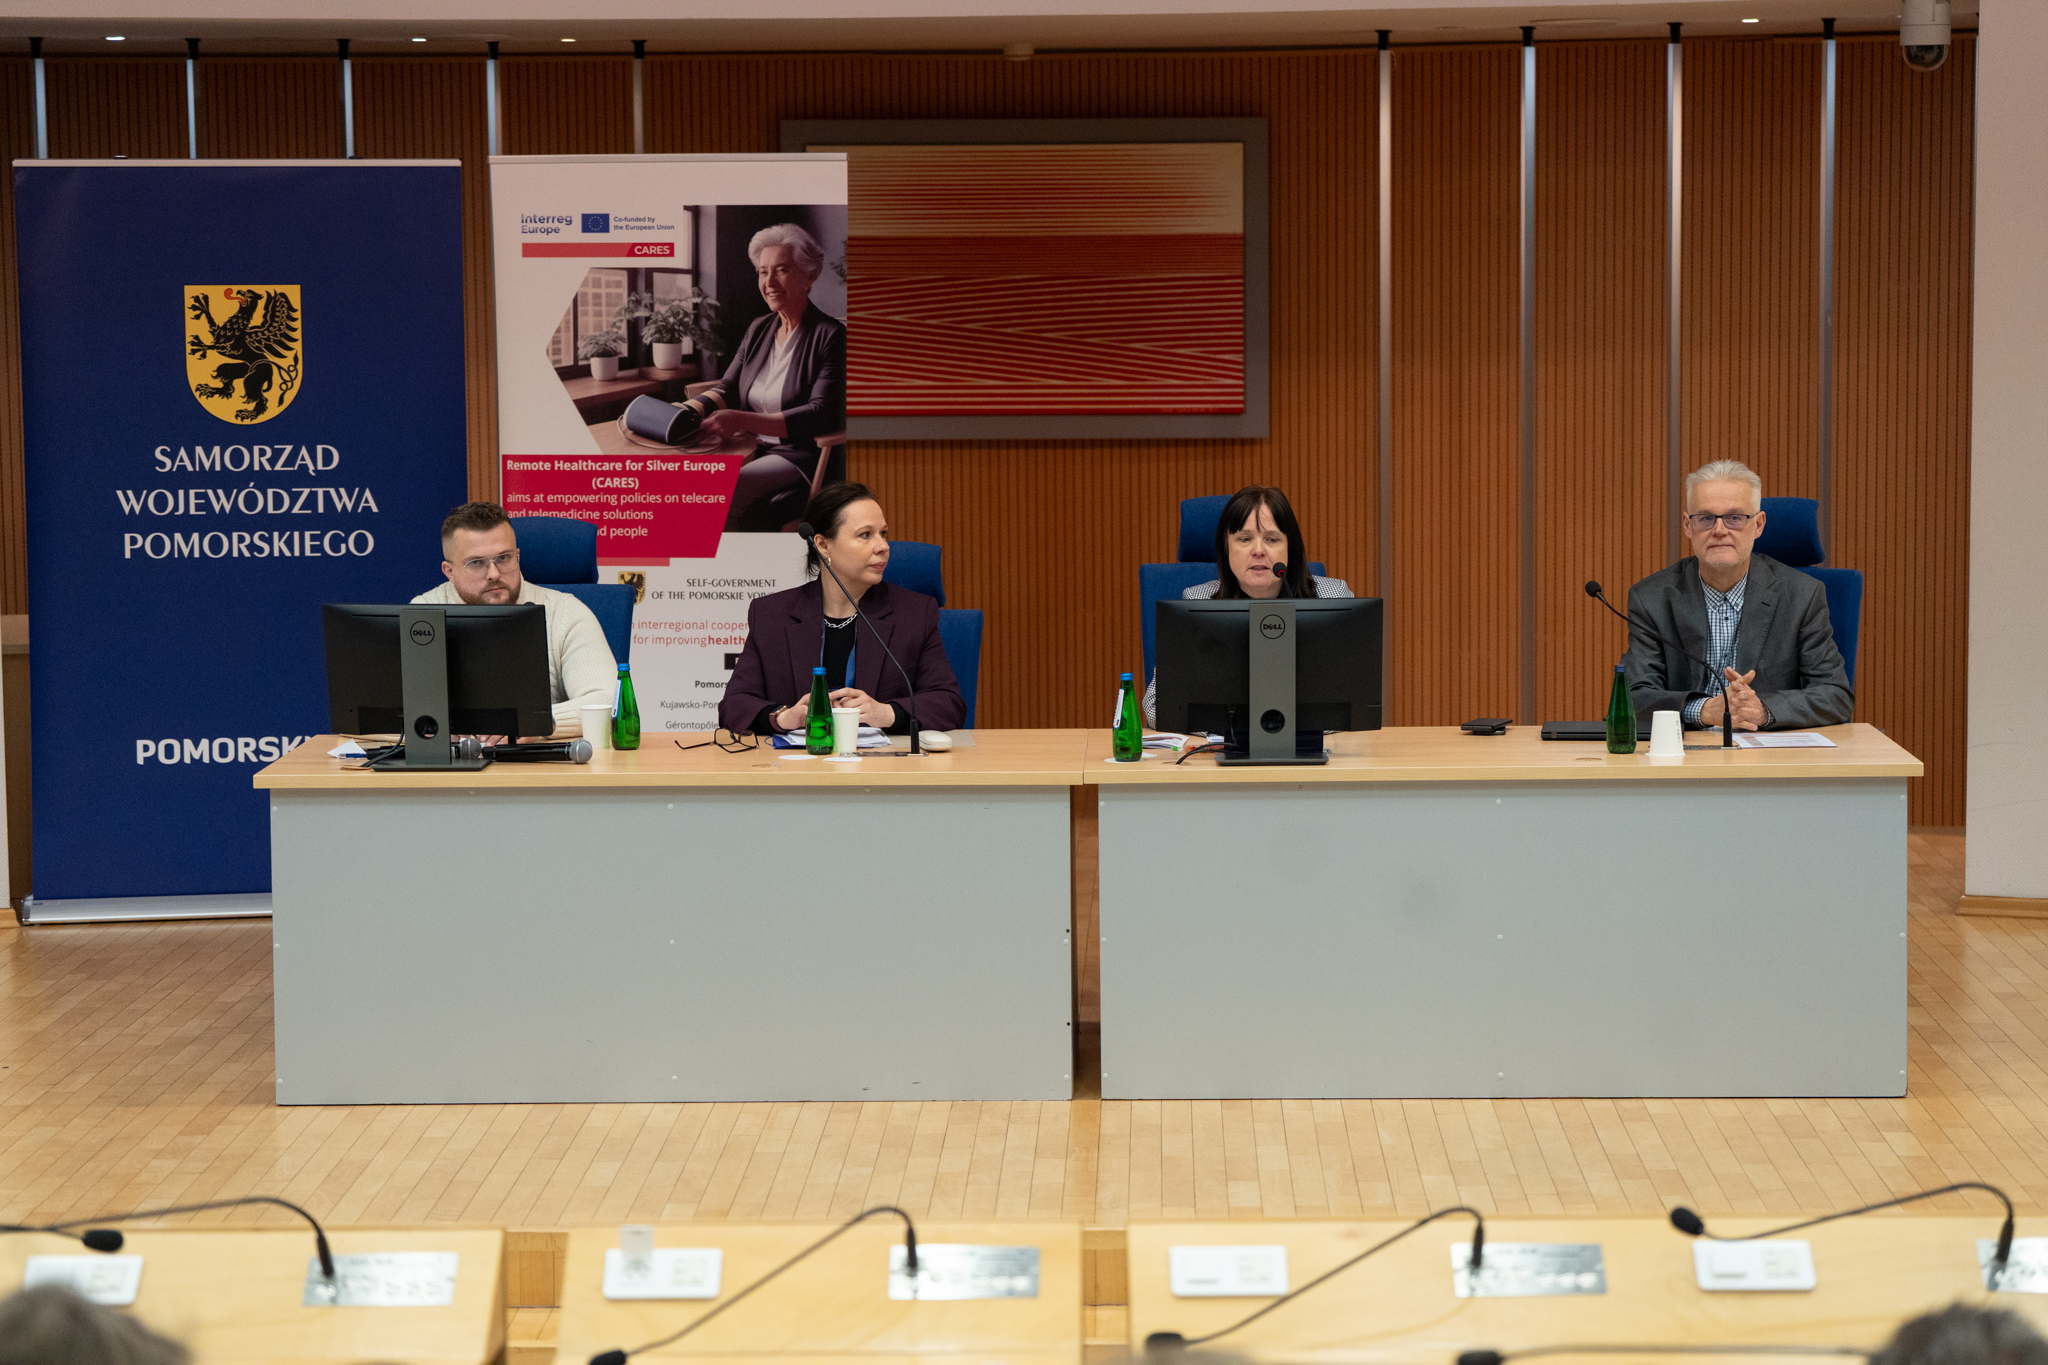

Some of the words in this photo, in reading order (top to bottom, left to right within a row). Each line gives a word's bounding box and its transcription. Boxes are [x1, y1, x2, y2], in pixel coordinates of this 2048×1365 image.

[521, 213, 573, 225] Interreg
[648, 216, 656, 225] by
[521, 225, 561, 235] Europe
[625, 224, 655, 233] European
[634, 245, 670, 255] CARES
[154, 444, 340, 476] SAMORZĄD
[506, 460, 551, 471] Remote
[554, 460, 623, 471] Healthcare
[625, 460, 643, 471] for
[646, 460, 680, 471] Silver
[683, 460, 726, 474] Europe
[591, 477, 640, 490] (CARES)
[115, 481, 379, 516] WOJEWÓDZTWA
[506, 493, 531, 503] aims
[534, 494, 544, 503] at
[547, 493, 618, 506] empowering
[620, 492, 662, 506] policies
[665, 495, 679, 503] on
[681, 492, 726, 503] telecare
[507, 509, 526, 518] and
[528, 509, 600, 519] telemedicine
[602, 509, 654, 519] solutions
[610, 525, 648, 539] people
[124, 530, 375, 559] POMORSKIEGO
[686, 578, 777, 588] SELF-GOVERNMENT
[651, 591, 665, 600] OF
[668, 591, 686, 600] THE
[688, 591, 744, 601] POMORSKIE
[637, 619, 709, 632] interregional
[633, 634, 649, 645] for
[136, 736, 312, 765] POMORSK
